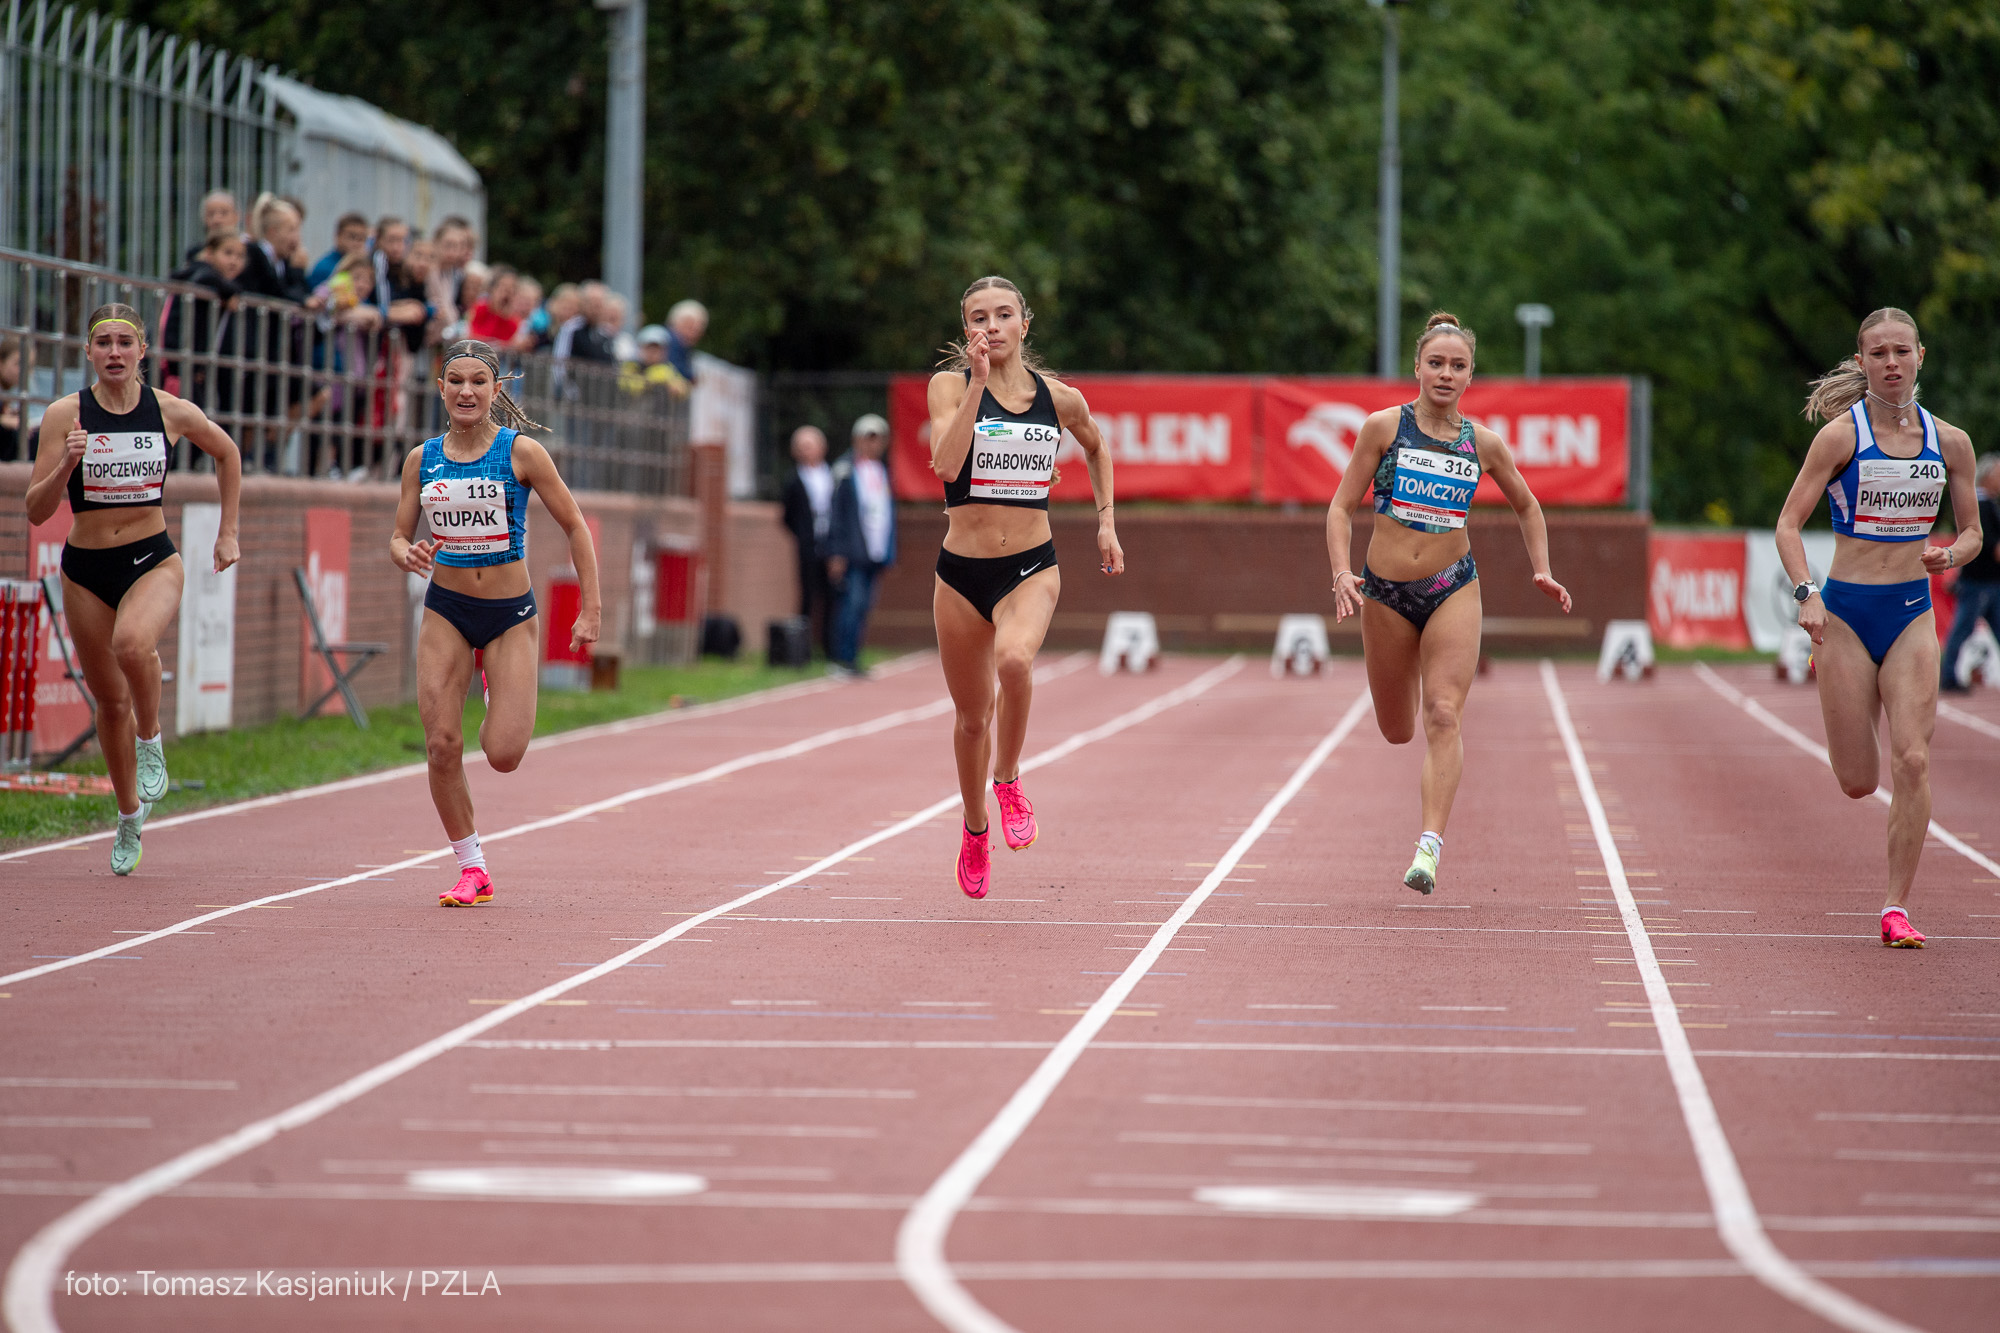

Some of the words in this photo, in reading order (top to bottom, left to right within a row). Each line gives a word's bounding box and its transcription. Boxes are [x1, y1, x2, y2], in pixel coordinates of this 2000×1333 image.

[1024, 427, 1054, 442] 656
[134, 436, 153, 449] 85
[87, 460, 163, 478] TOPCZEWSKA
[976, 452, 1052, 471] GRABOWSKA
[1409, 456, 1436, 468] FUEL
[1444, 459, 1473, 477] 316
[1909, 464, 1939, 479] 240
[467, 484, 498, 499] 113
[991, 488, 1020, 496] SŁUBICE
[1398, 475, 1471, 503] TOMCZYK
[1860, 490, 1940, 511] PIĄTKOWSKA
[432, 510, 498, 527] CIUPAK
[1406, 511, 1434, 521] SŁUBICE
[1434, 516, 1451, 524] 2023
[1905, 525, 1920, 533] 2023
